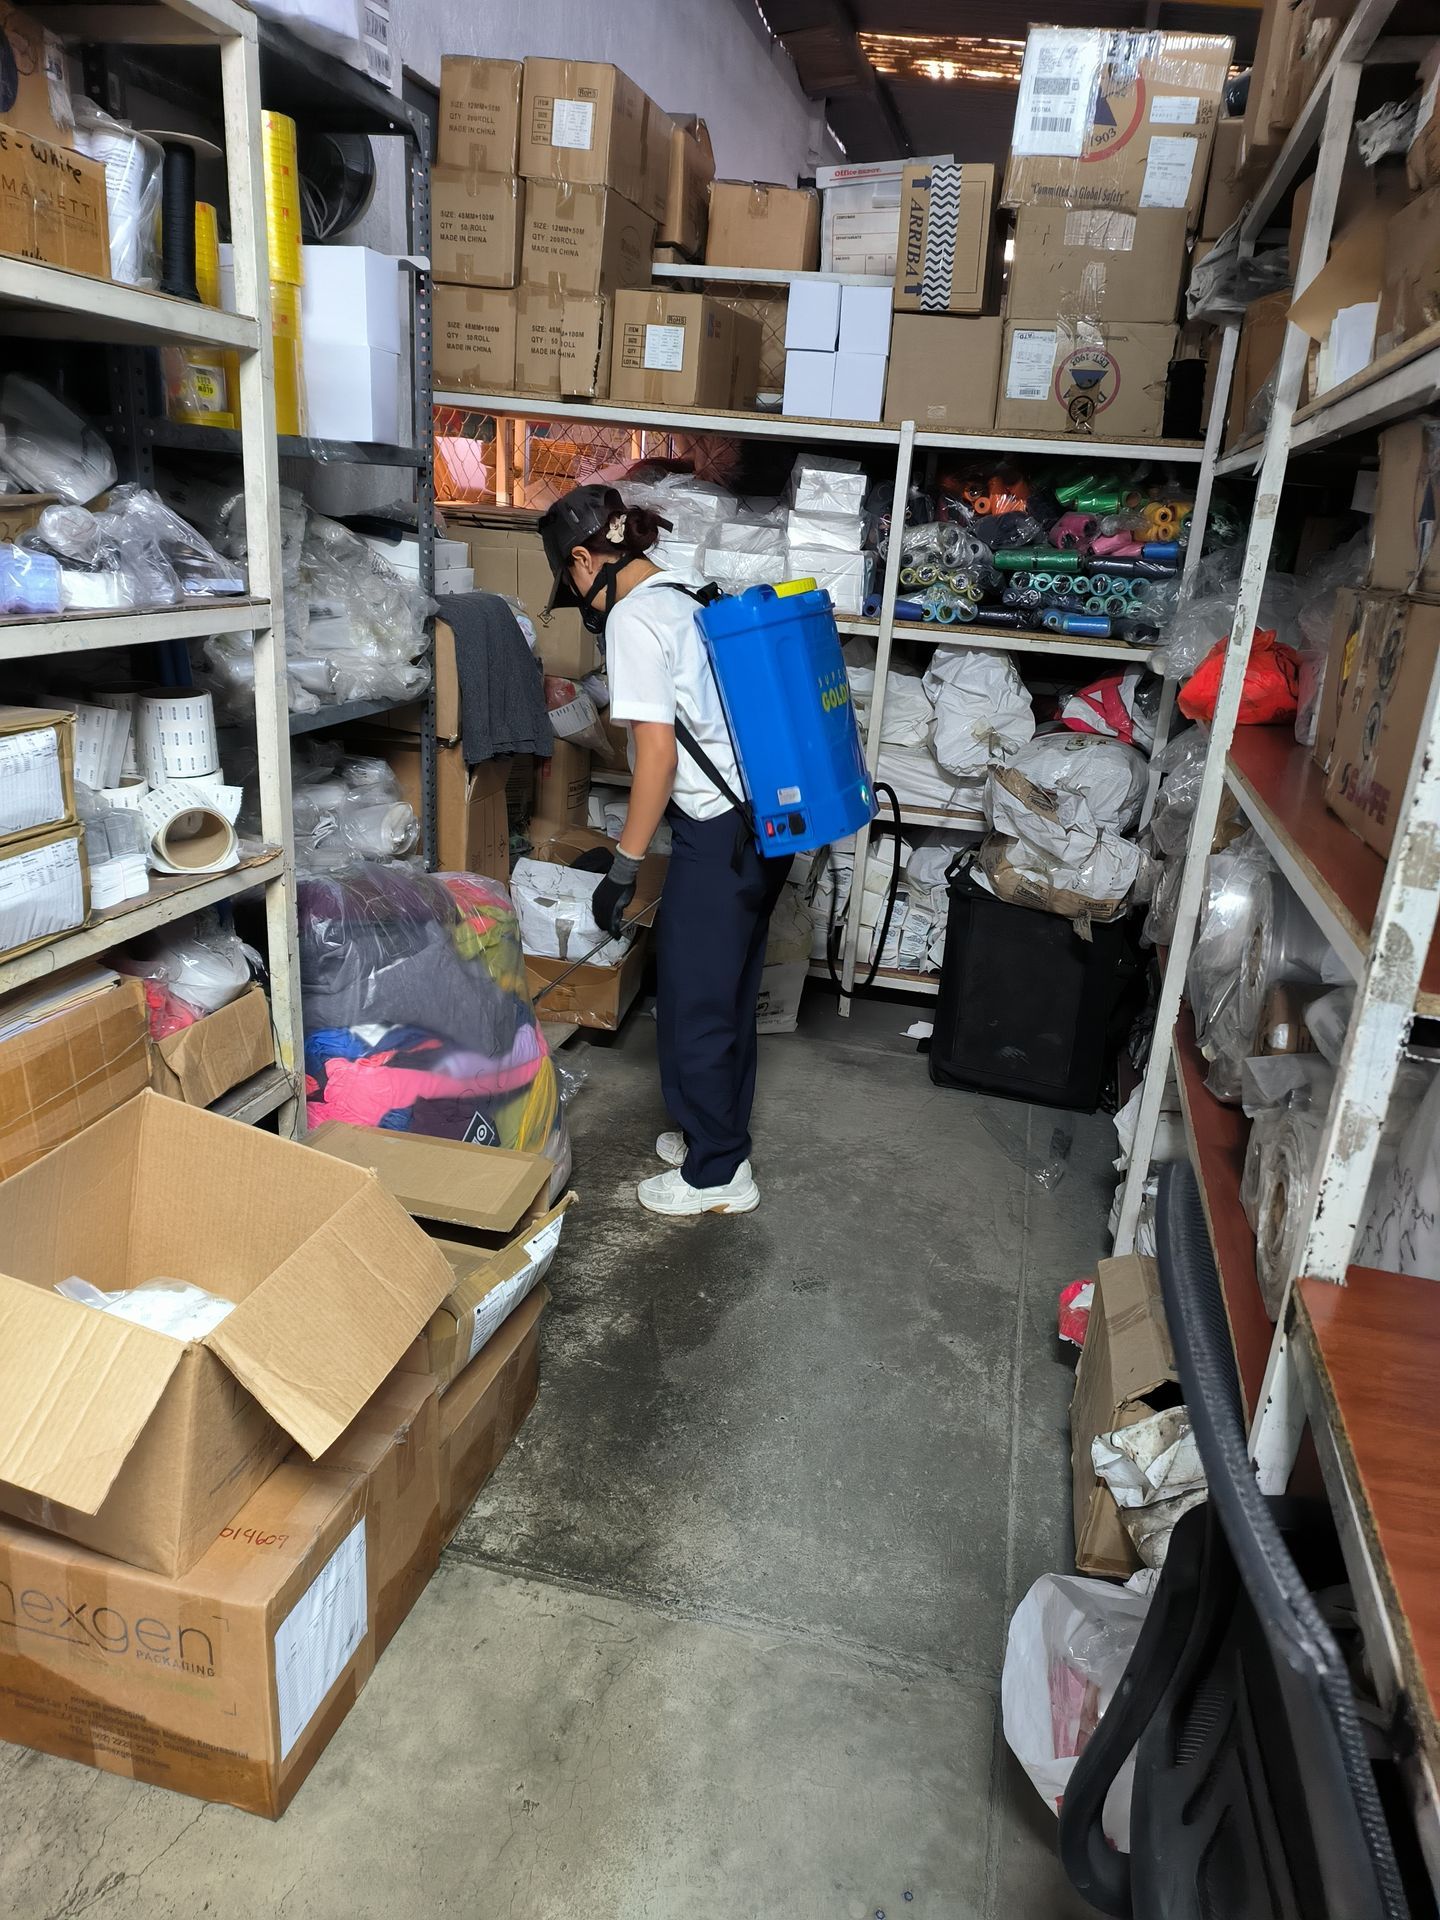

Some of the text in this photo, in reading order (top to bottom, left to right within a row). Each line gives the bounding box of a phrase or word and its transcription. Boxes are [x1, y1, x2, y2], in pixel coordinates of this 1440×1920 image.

[449, 124, 497, 136] MADE IN CHINA
[1091, 128, 1117, 147] 1903
[834, 169, 857, 178] Office
[1079, 186, 1102, 200] Global
[440, 233, 458, 242] MADE
[467, 235, 488, 243] CHINA
[905, 197, 925, 277] ARRIBA
[531, 244, 550, 254] MADE
[559, 248, 580, 257] CHINA
[446, 342, 492, 353] MADE IN CHINA
[530, 347, 548, 355] MADE
[549, 348, 557, 356] IN
